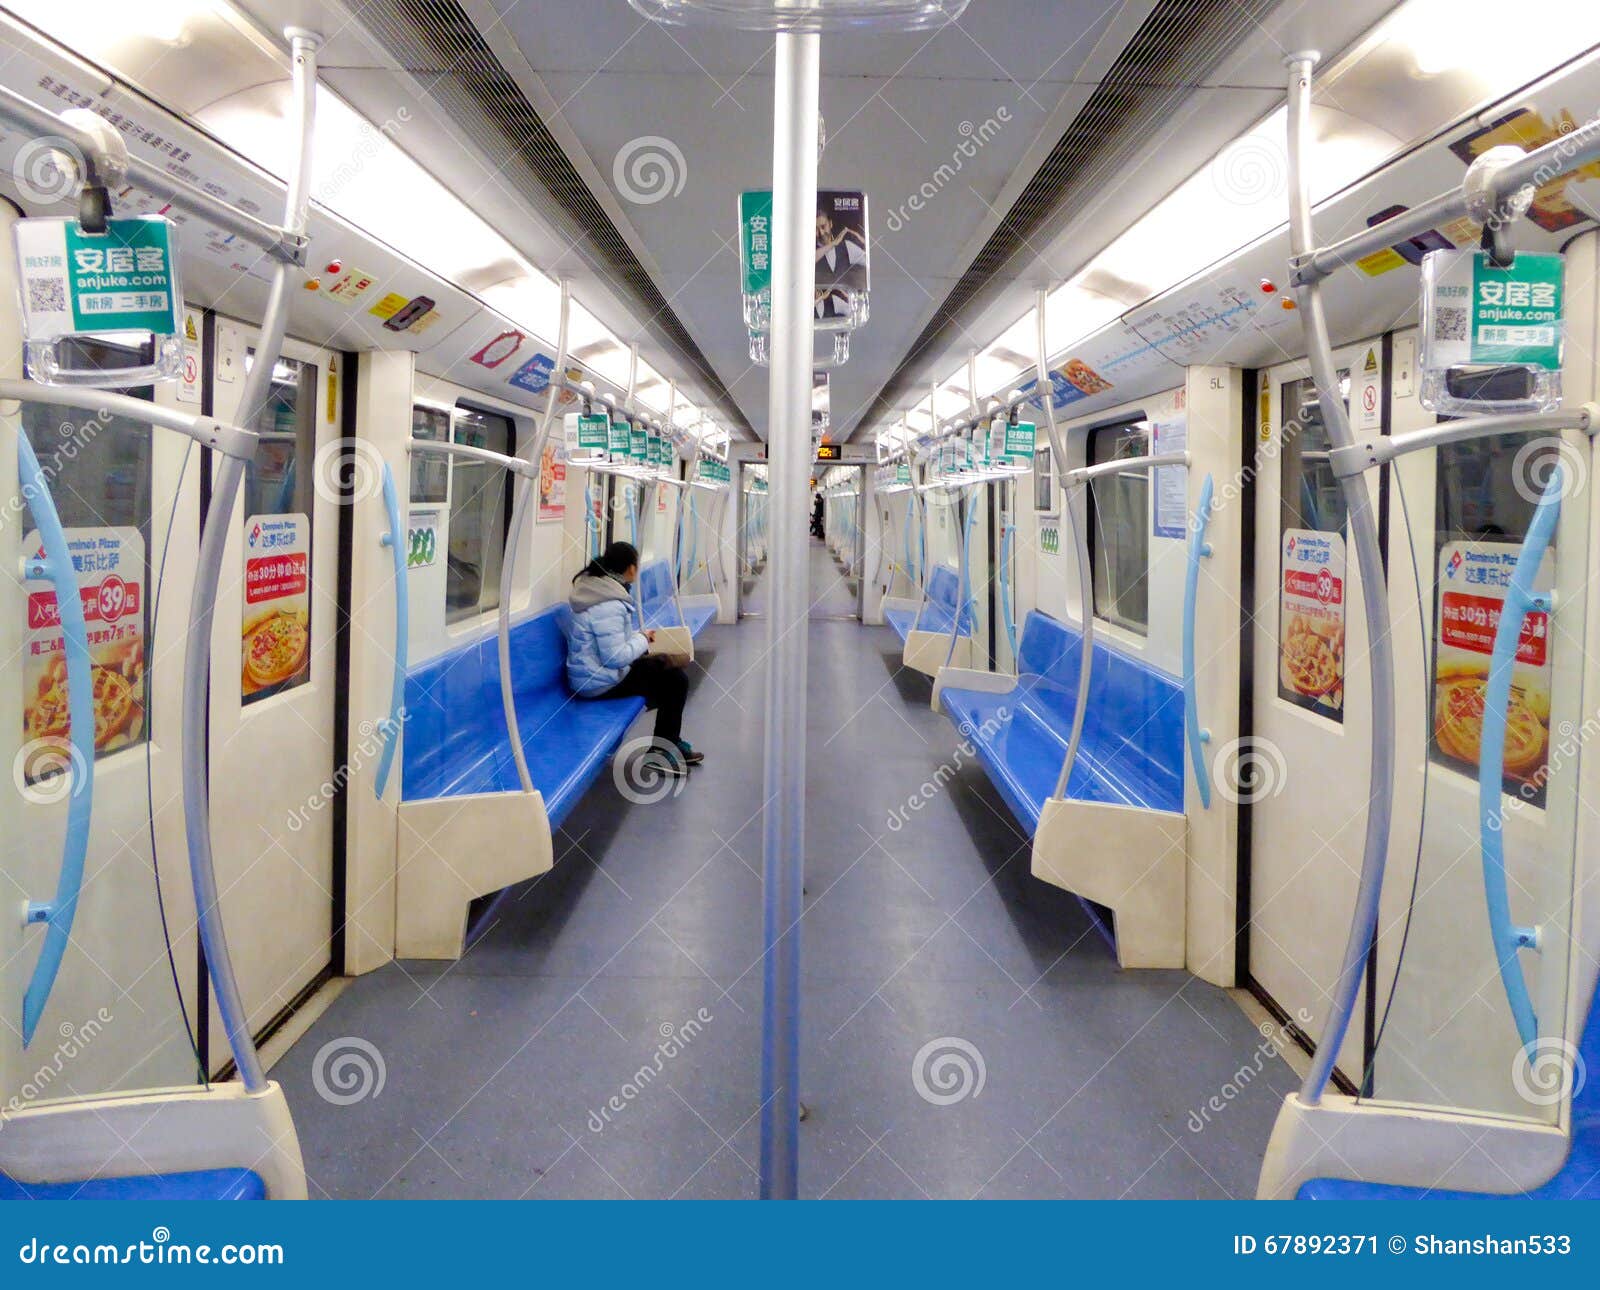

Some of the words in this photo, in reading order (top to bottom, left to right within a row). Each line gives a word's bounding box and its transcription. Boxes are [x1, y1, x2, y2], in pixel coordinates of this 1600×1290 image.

[750, 214, 768, 270] 安居客
[74, 246, 165, 274] 安居客
[76, 273, 167, 289] anjuke.com
[1479, 280, 1556, 307] 安居客
[86, 296, 113, 310] 新房
[120, 295, 162, 308] 二手房
[1478, 308, 1556, 321] anjuke.com
[1210, 376, 1225, 390] 5L
[98, 538, 120, 548] Pizza
[71, 553, 120, 572] 美乐比萨
[1465, 551, 1500, 564] Domino's
[1465, 567, 1511, 587] 达美乐比
[102, 585, 123, 613] 39
